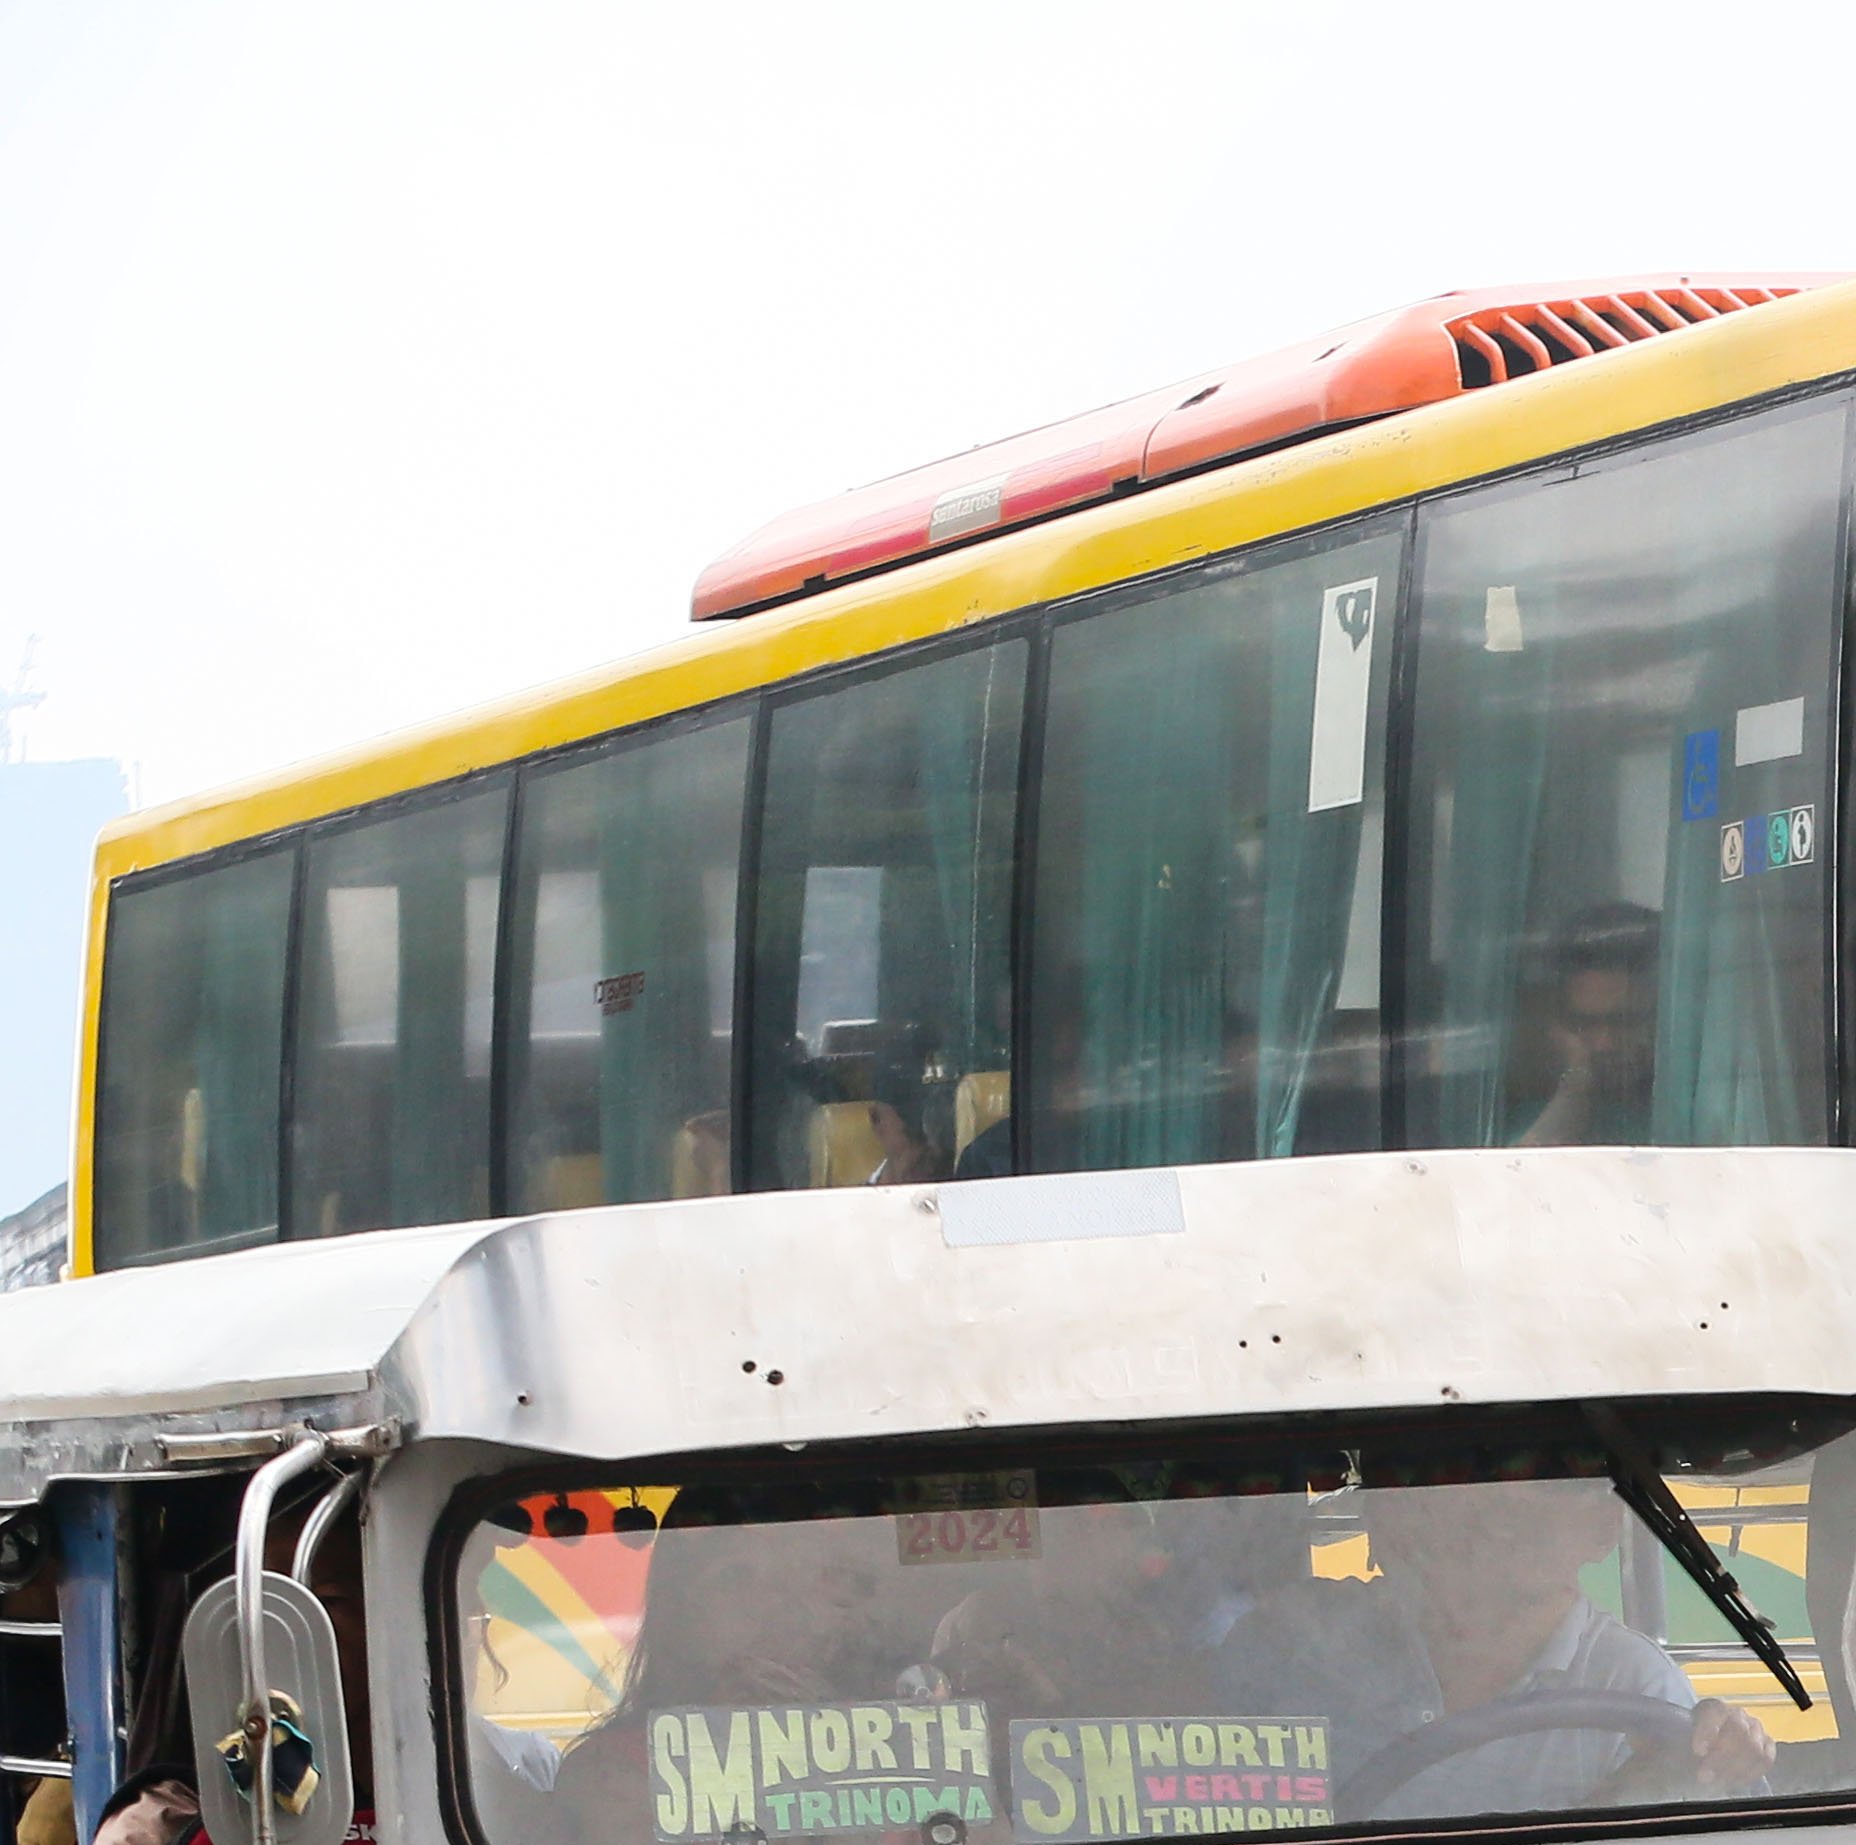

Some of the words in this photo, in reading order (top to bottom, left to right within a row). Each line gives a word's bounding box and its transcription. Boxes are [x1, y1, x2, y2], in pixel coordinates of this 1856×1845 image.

[903, 1507, 1034, 1555] 2024
[653, 1711, 757, 1836] SM
[758, 1705, 990, 1788] NORTH
[1021, 1724, 1141, 1836] SM
[1137, 1722, 1328, 1770] NORTH
[1144, 1773, 1329, 1802] VERTIS
[765, 1786, 994, 1831] TRINOMA
